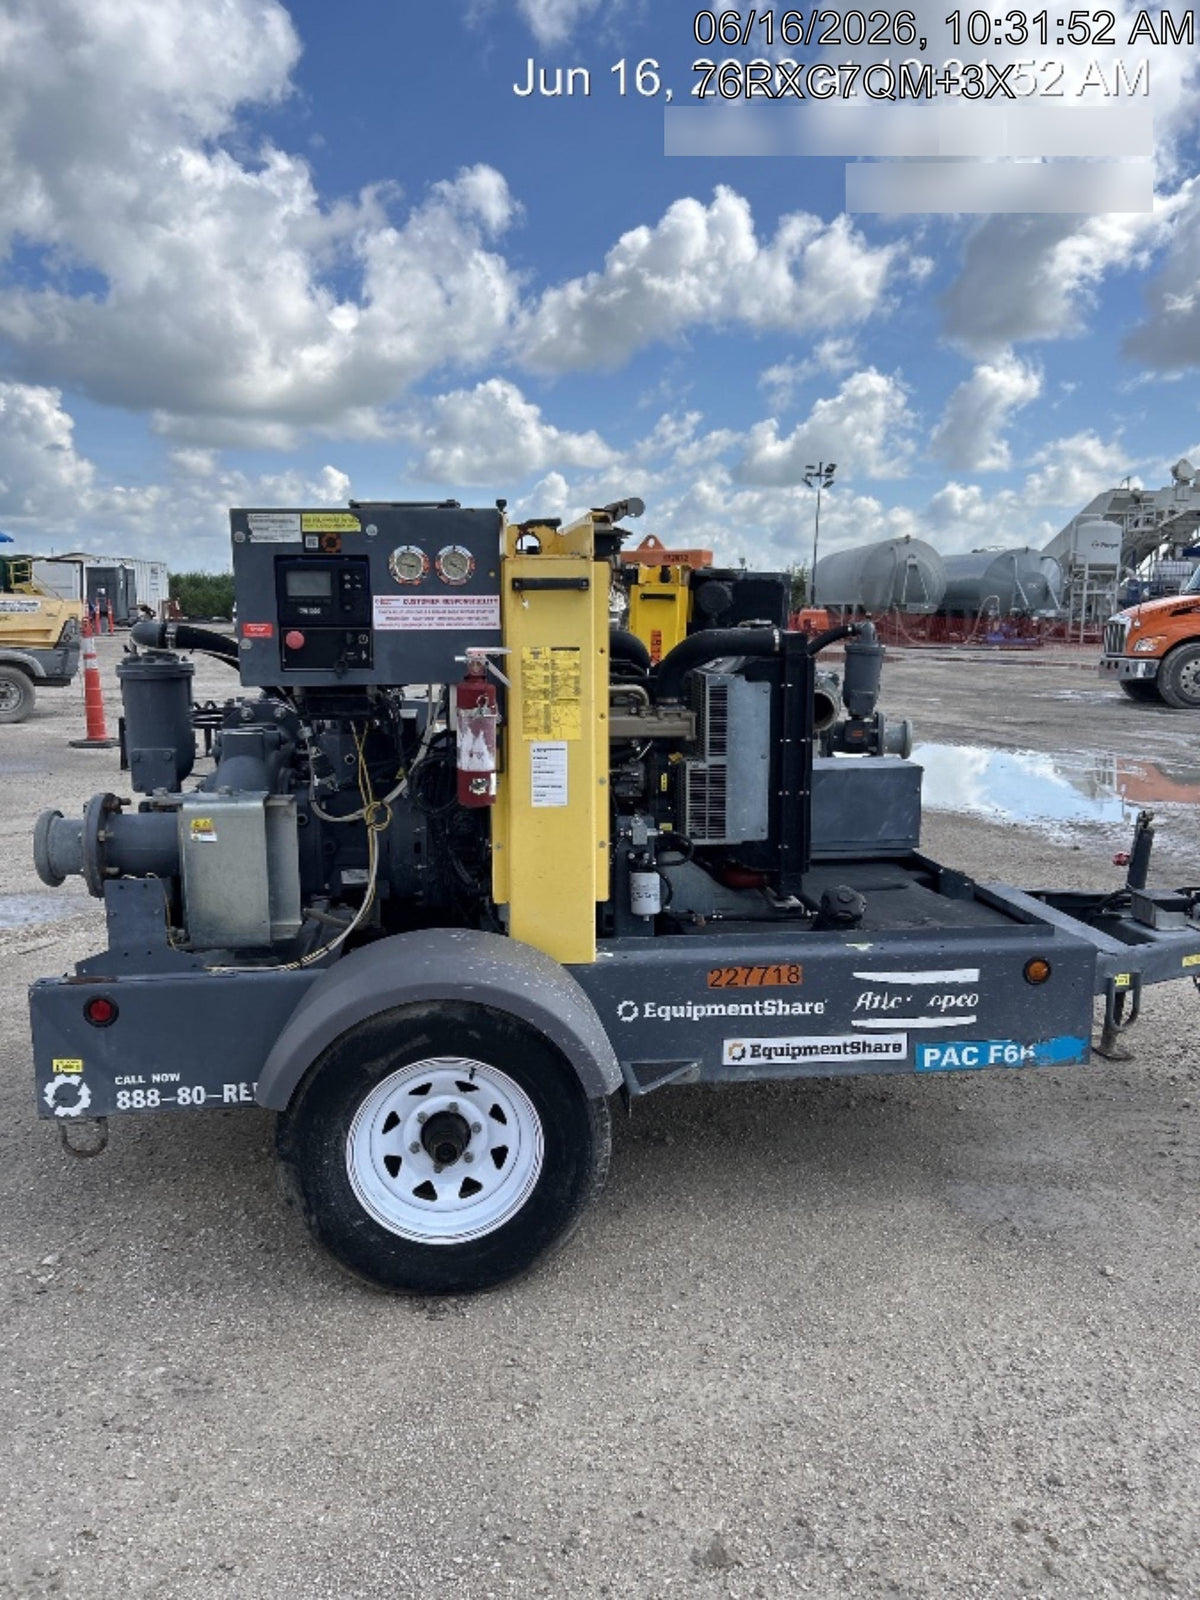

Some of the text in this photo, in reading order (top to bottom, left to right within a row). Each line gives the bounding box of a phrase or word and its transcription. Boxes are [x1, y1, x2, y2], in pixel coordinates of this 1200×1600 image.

[708, 965, 801, 988] 227718
[643, 998, 826, 1021] EquipmentShare
[749, 1040, 903, 1060] EquipmentShare
[924, 1046, 979, 1068] PAC
[114, 1072, 181, 1086] CALL NOW
[115, 1081, 259, 1110] 888-80-RE
